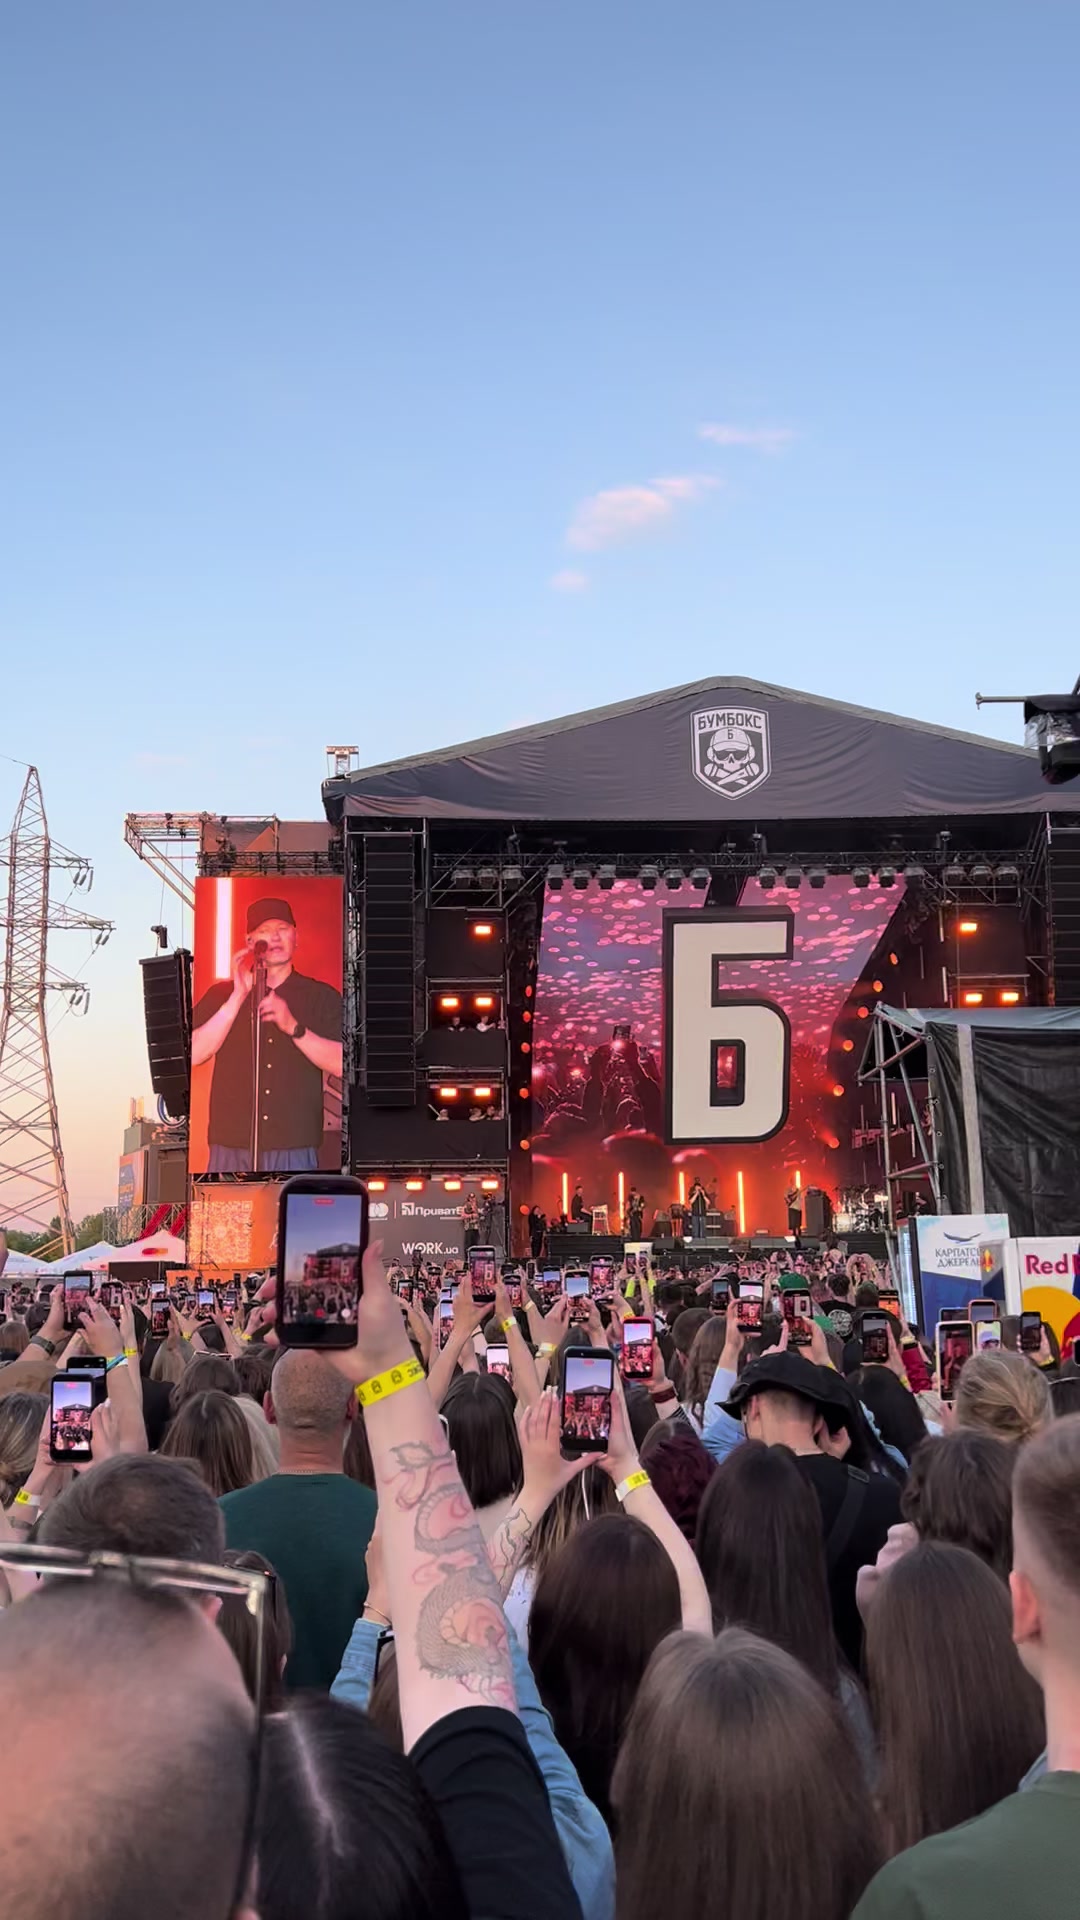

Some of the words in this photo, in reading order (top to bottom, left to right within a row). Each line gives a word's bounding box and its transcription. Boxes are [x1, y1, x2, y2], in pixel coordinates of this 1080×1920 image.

[698, 712, 762, 730] БУМБОКС
[727, 728, 734, 740] Б
[664, 907, 794, 1144] Б
[401, 1242, 459, 1255] WORK.ua
[1025, 1253, 1069, 1275] Red
